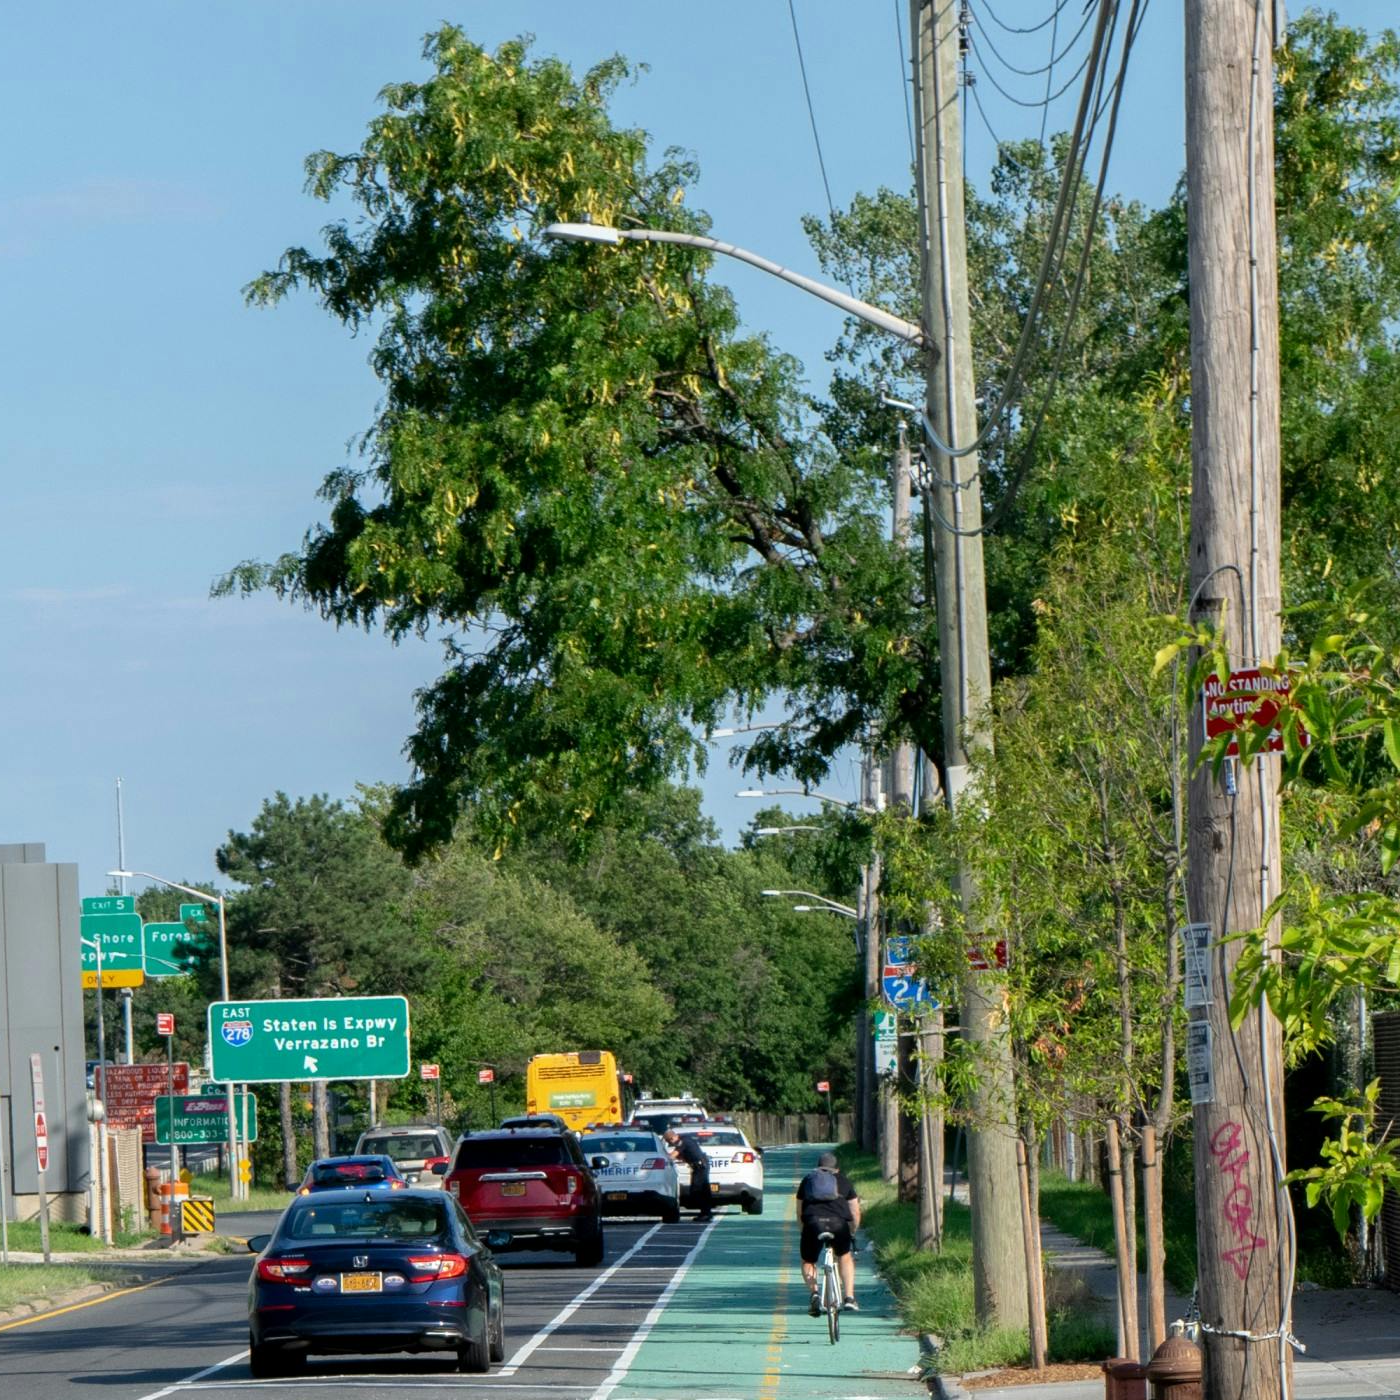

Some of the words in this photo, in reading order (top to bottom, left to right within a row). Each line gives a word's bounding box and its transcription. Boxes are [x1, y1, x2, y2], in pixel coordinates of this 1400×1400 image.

[1209, 682, 1225, 696] NO
[1229, 674, 1289, 691] STANDING
[116, 899, 125, 910] 5
[93, 933, 134, 943] Shore
[152, 931, 193, 942] Fores
[80, 952, 115, 962] xpwy
[892, 979, 926, 1004] 27
[223, 1008, 251, 1018] EAST
[263, 1019, 317, 1032] Staten
[324, 1018, 337, 1030] Is
[344, 1017, 397, 1031] Expwy
[226, 1029, 250, 1041] 278
[274, 1036, 359, 1051] Verrazano
[366, 1035, 385, 1048] Br
[174, 1117, 237, 1127] INFORMATI
[709, 1160, 729, 1168] RIFF
